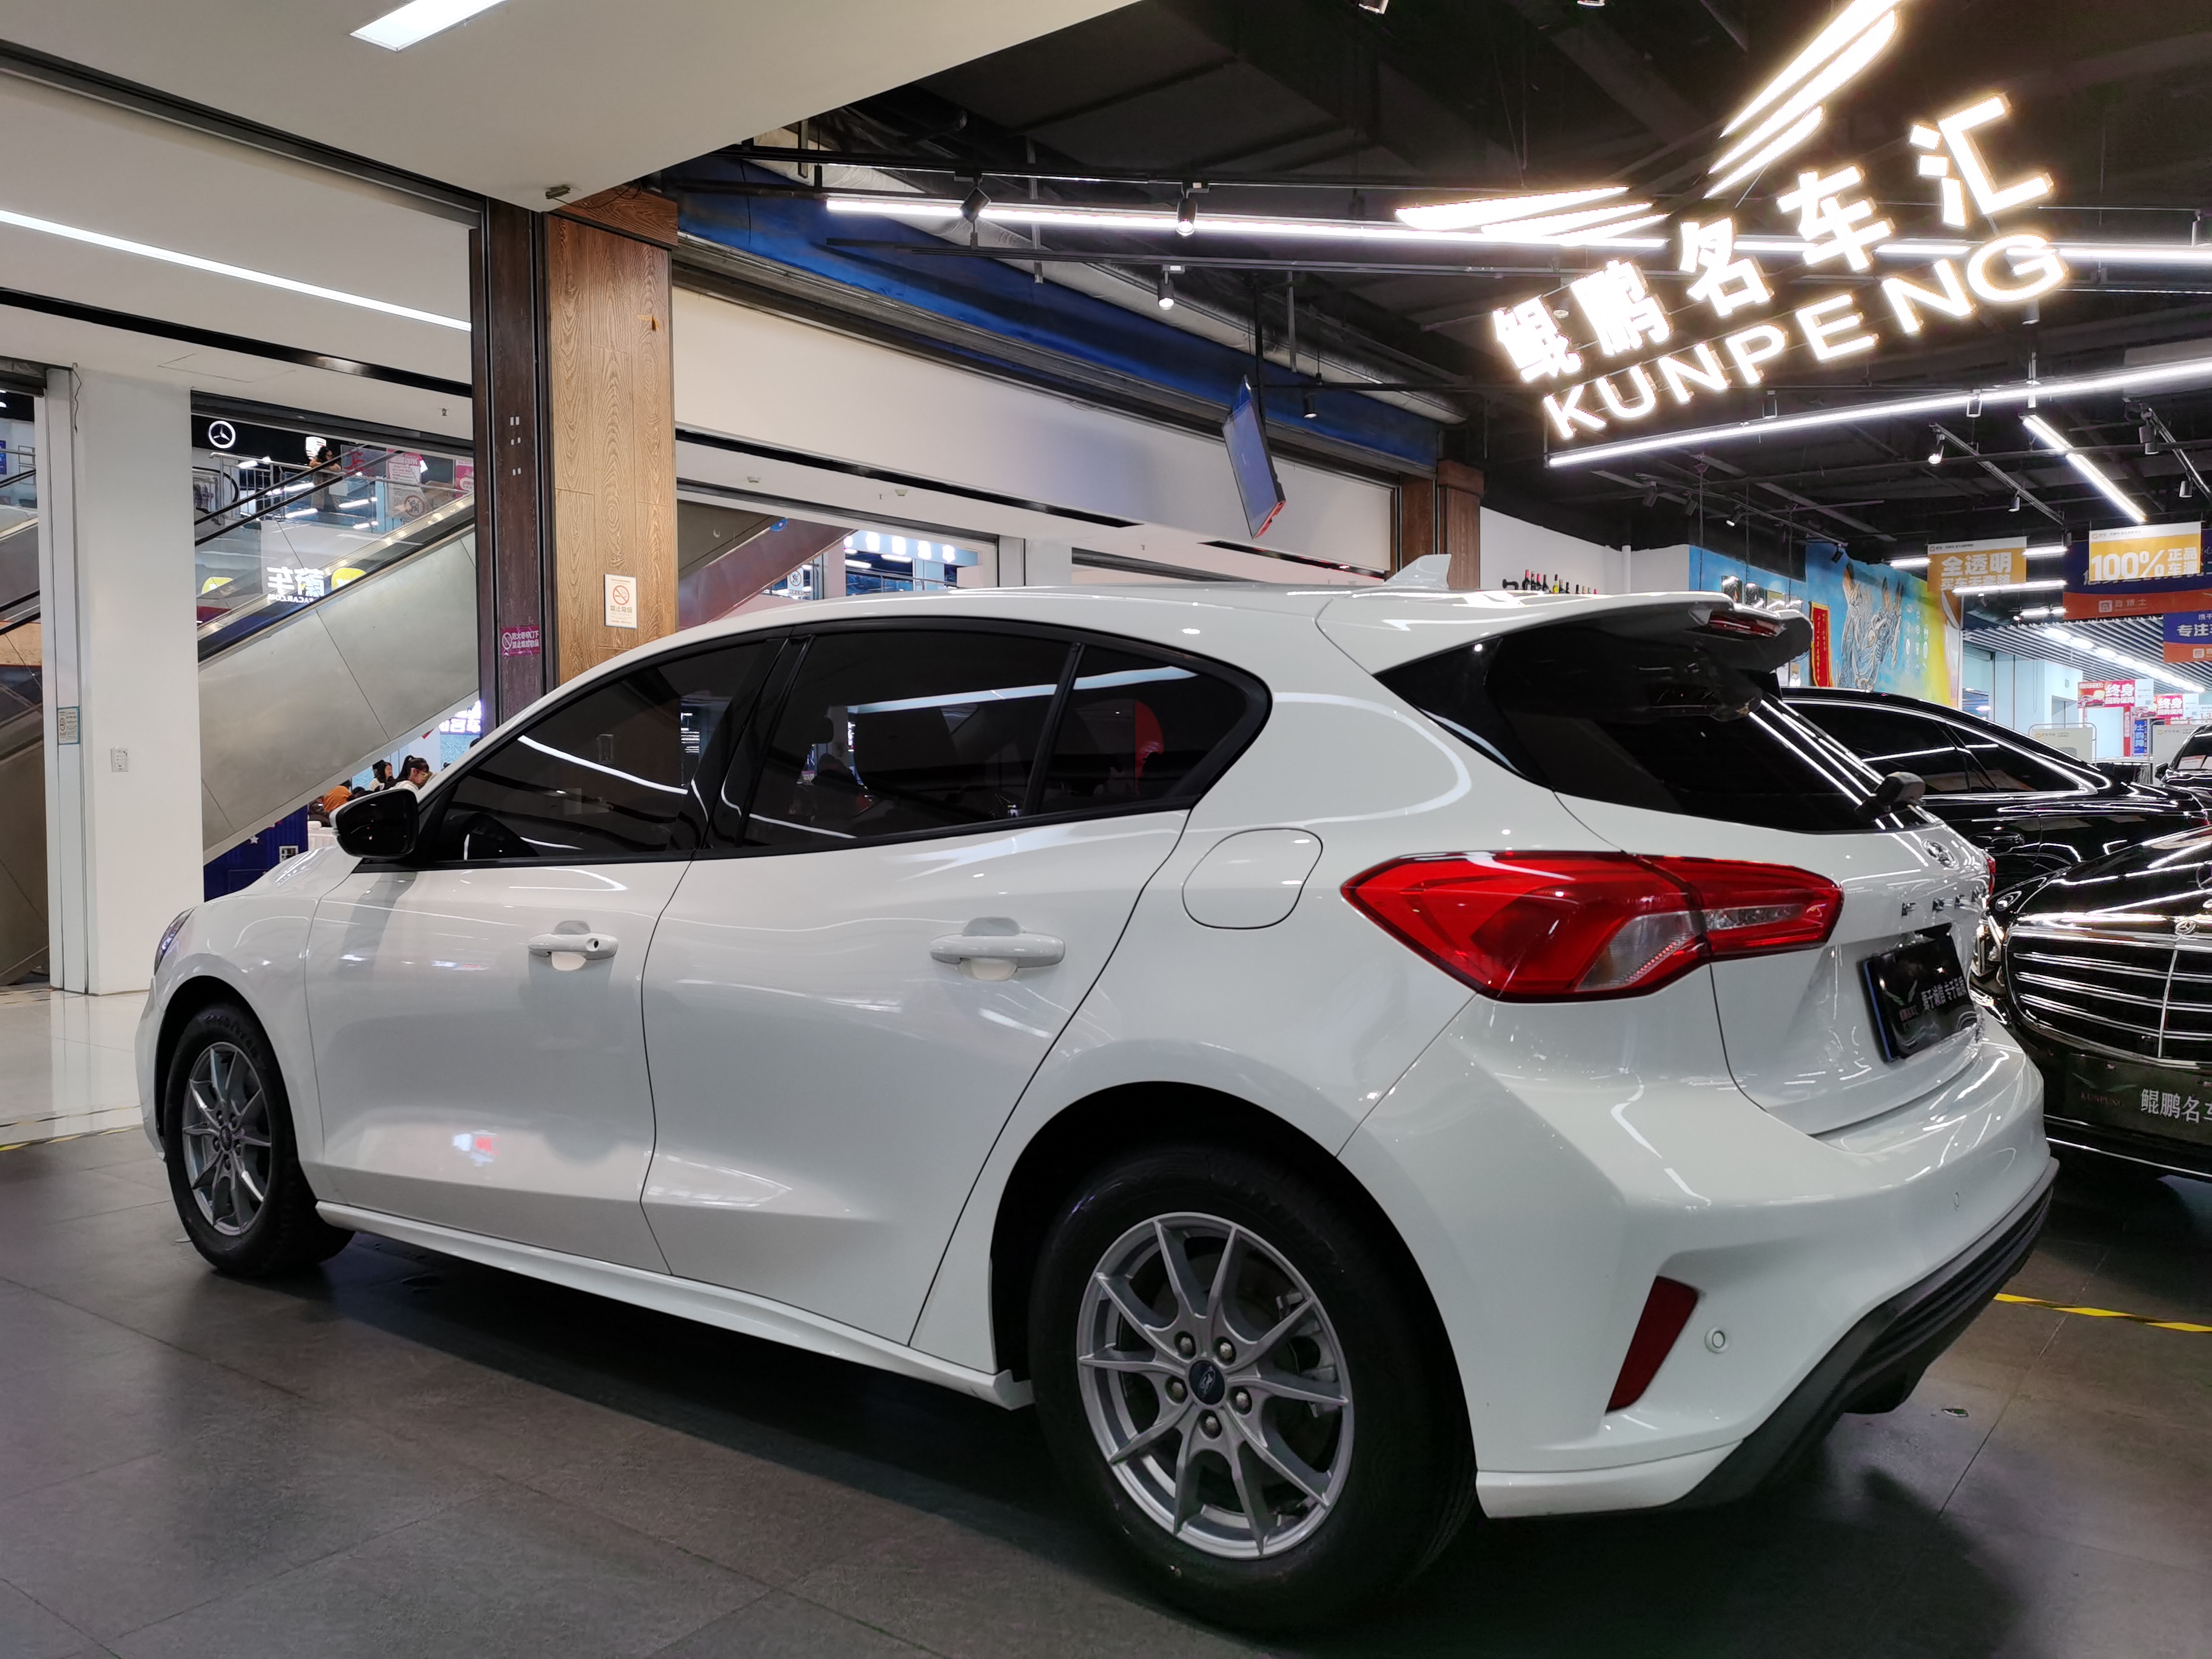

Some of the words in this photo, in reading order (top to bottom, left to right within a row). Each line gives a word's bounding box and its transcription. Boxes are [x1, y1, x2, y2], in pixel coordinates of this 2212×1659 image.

[1492, 92, 2056, 383] 鲲鹏名车汇
[1542, 233, 2069, 439] KUNPENG
[2167, 547, 2197, 561] 正品
[1941, 552, 2012, 577] 全透明
[2091, 549, 2165, 581] 100%
[2167, 561, 2197, 575] 车源
[2177, 623, 2212, 637] 专注
[2105, 683, 2134, 697] 终身
[2157, 697, 2182, 709] 终身
